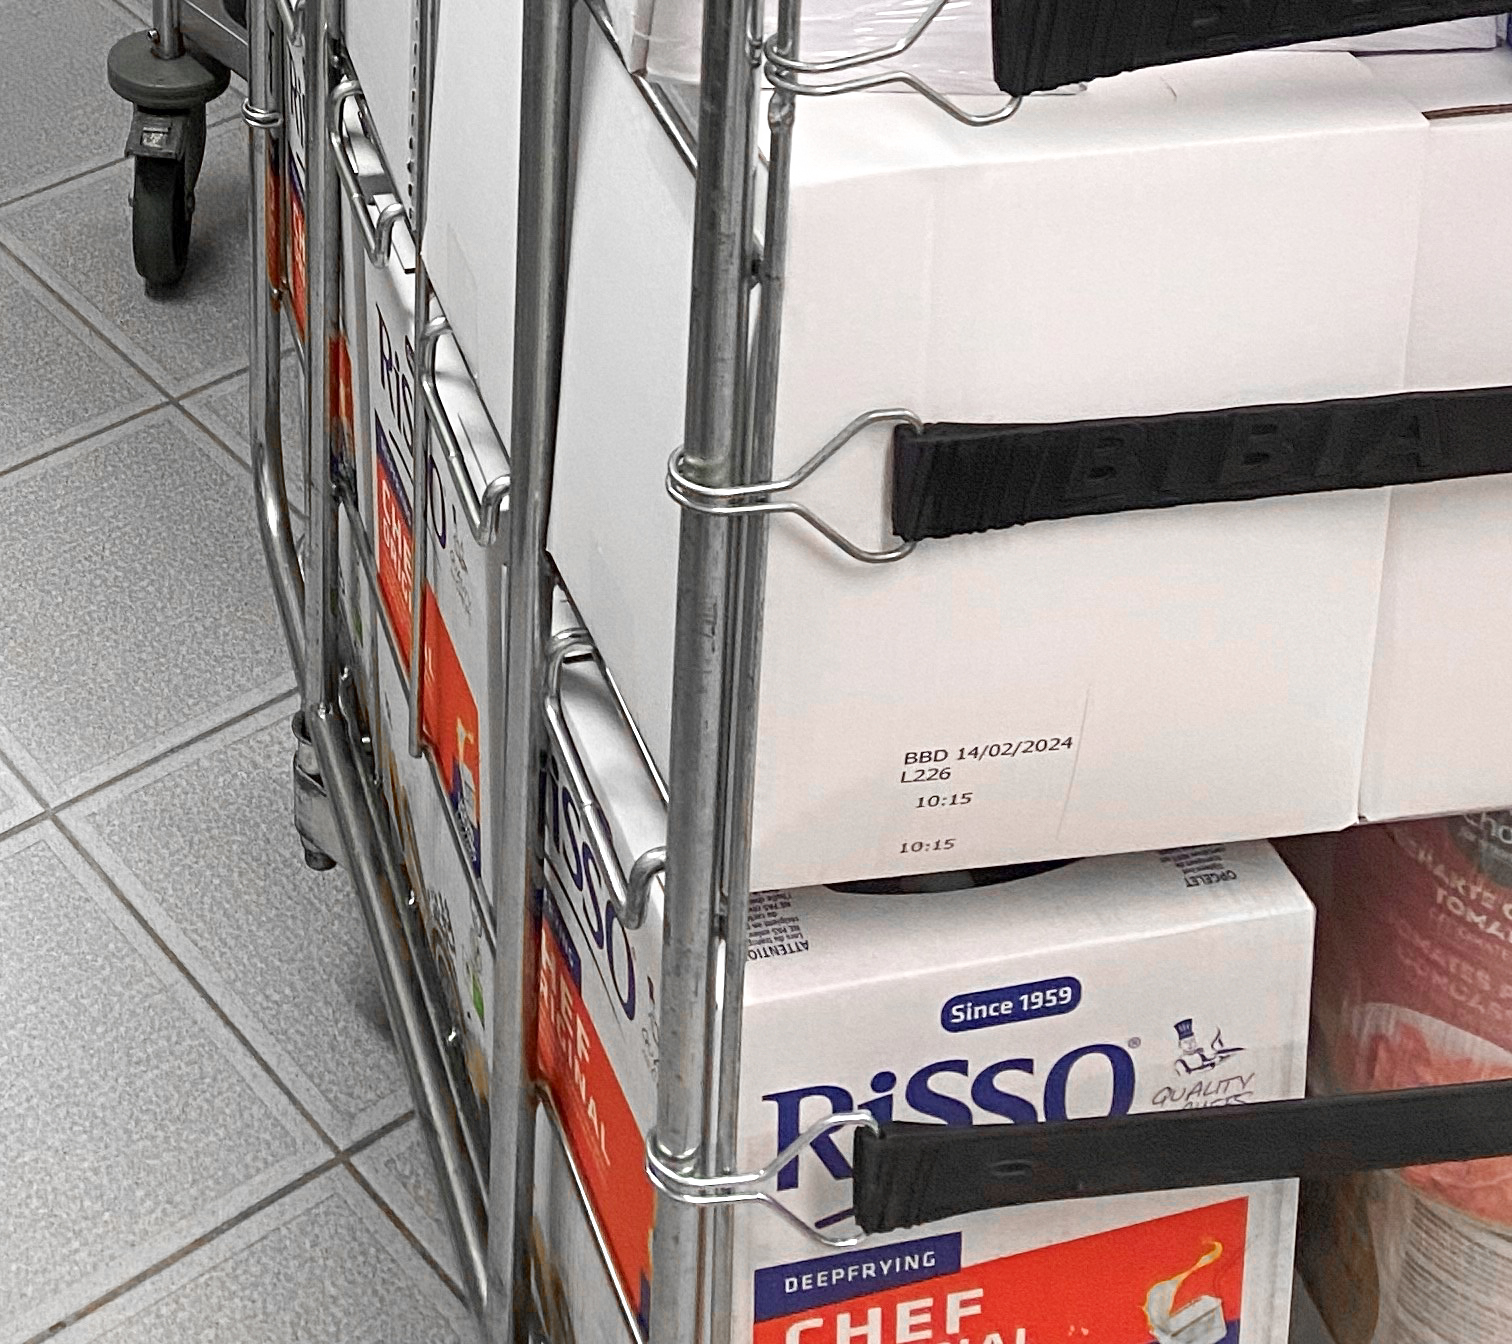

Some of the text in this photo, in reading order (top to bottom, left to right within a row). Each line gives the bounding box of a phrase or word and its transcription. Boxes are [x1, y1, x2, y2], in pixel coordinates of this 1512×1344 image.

[903, 734, 1074, 767] BBD 14/02/2024
[900, 766, 952, 785] L226
[916, 792, 973, 810] 10:15
[899, 837, 956, 855] 10:15
[951, 985, 1073, 1024] Since 1959
[1152, 1072, 1255, 1106] QUALITY
[784, 1250, 937, 1294] DEEPFRYING
[784, 1287, 985, 1344] CHEF
